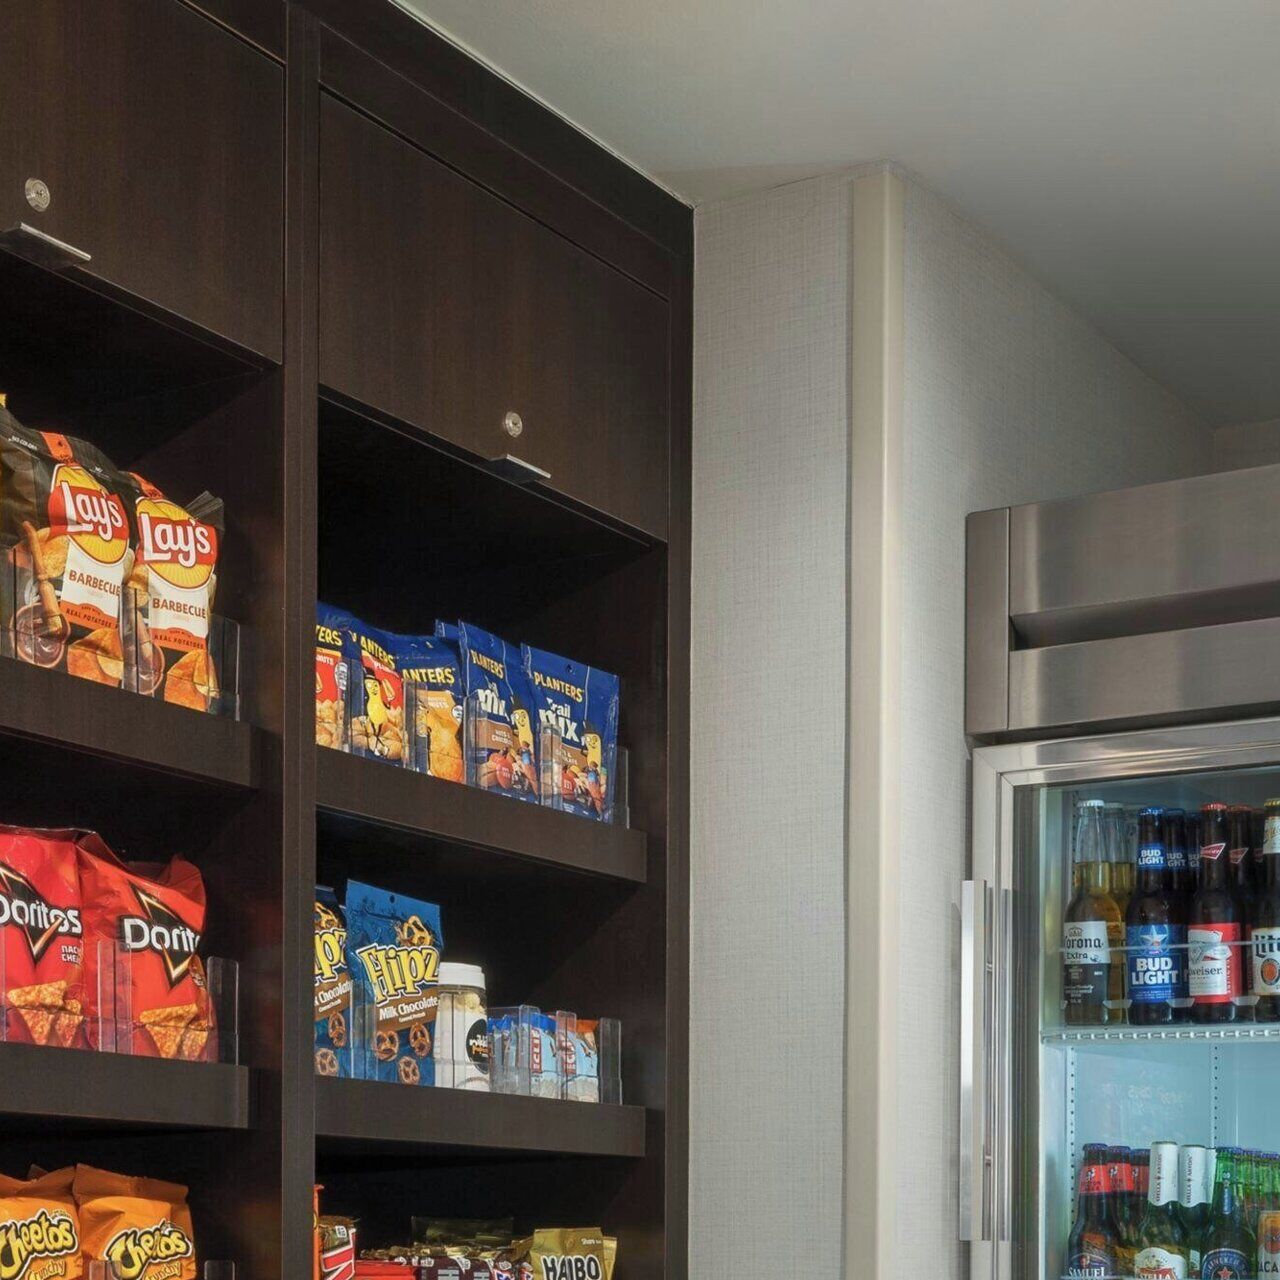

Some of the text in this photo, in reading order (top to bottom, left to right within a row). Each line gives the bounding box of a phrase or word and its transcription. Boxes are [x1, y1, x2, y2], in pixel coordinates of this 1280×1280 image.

[60, 480, 123, 541] Lay's
[140, 512, 211, 567] Lay's
[69, 570, 121, 598] BARBECUE
[152, 597, 206, 619] BARBECUE
[534, 671, 584, 703] PLANTERS
[359, 946, 440, 1005] Flipz
[1131, 970, 1179, 985] LIGHT
[1136, 957, 1173, 972] BUD
[379, 994, 439, 1022] Milk Chocolate
[1068, 1265, 1106, 1278] SAMUEL
